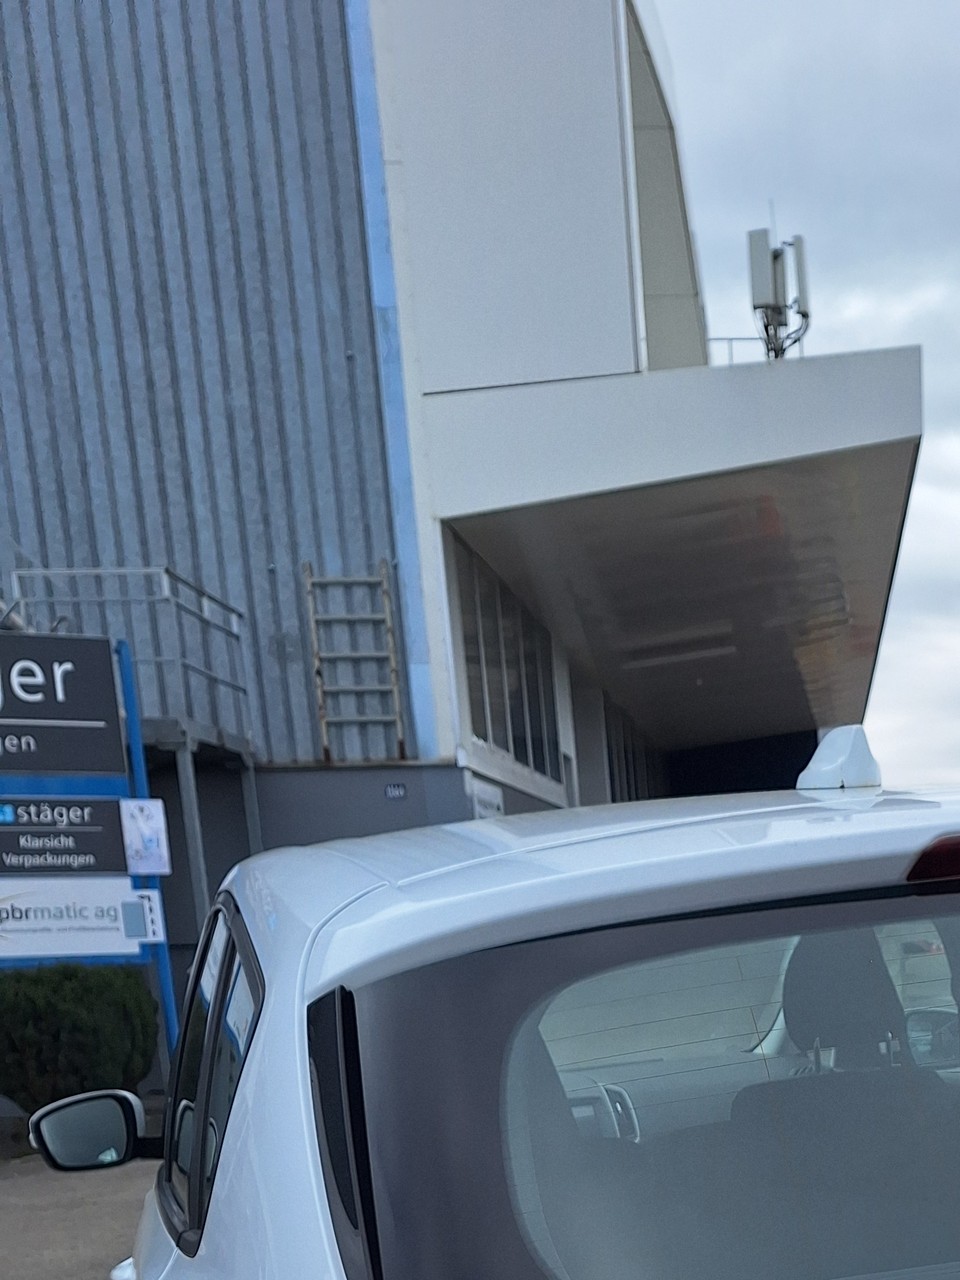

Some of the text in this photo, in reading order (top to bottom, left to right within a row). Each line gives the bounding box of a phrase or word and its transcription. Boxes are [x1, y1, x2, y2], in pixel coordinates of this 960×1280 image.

[0, 659, 75, 711] er
[0, 734, 37, 756] en
[16, 802, 93, 827] stäger
[18, 834, 76, 849] Klarsicht
[2, 852, 96, 868] Verpackungen
[94, 905, 118, 923] ag
